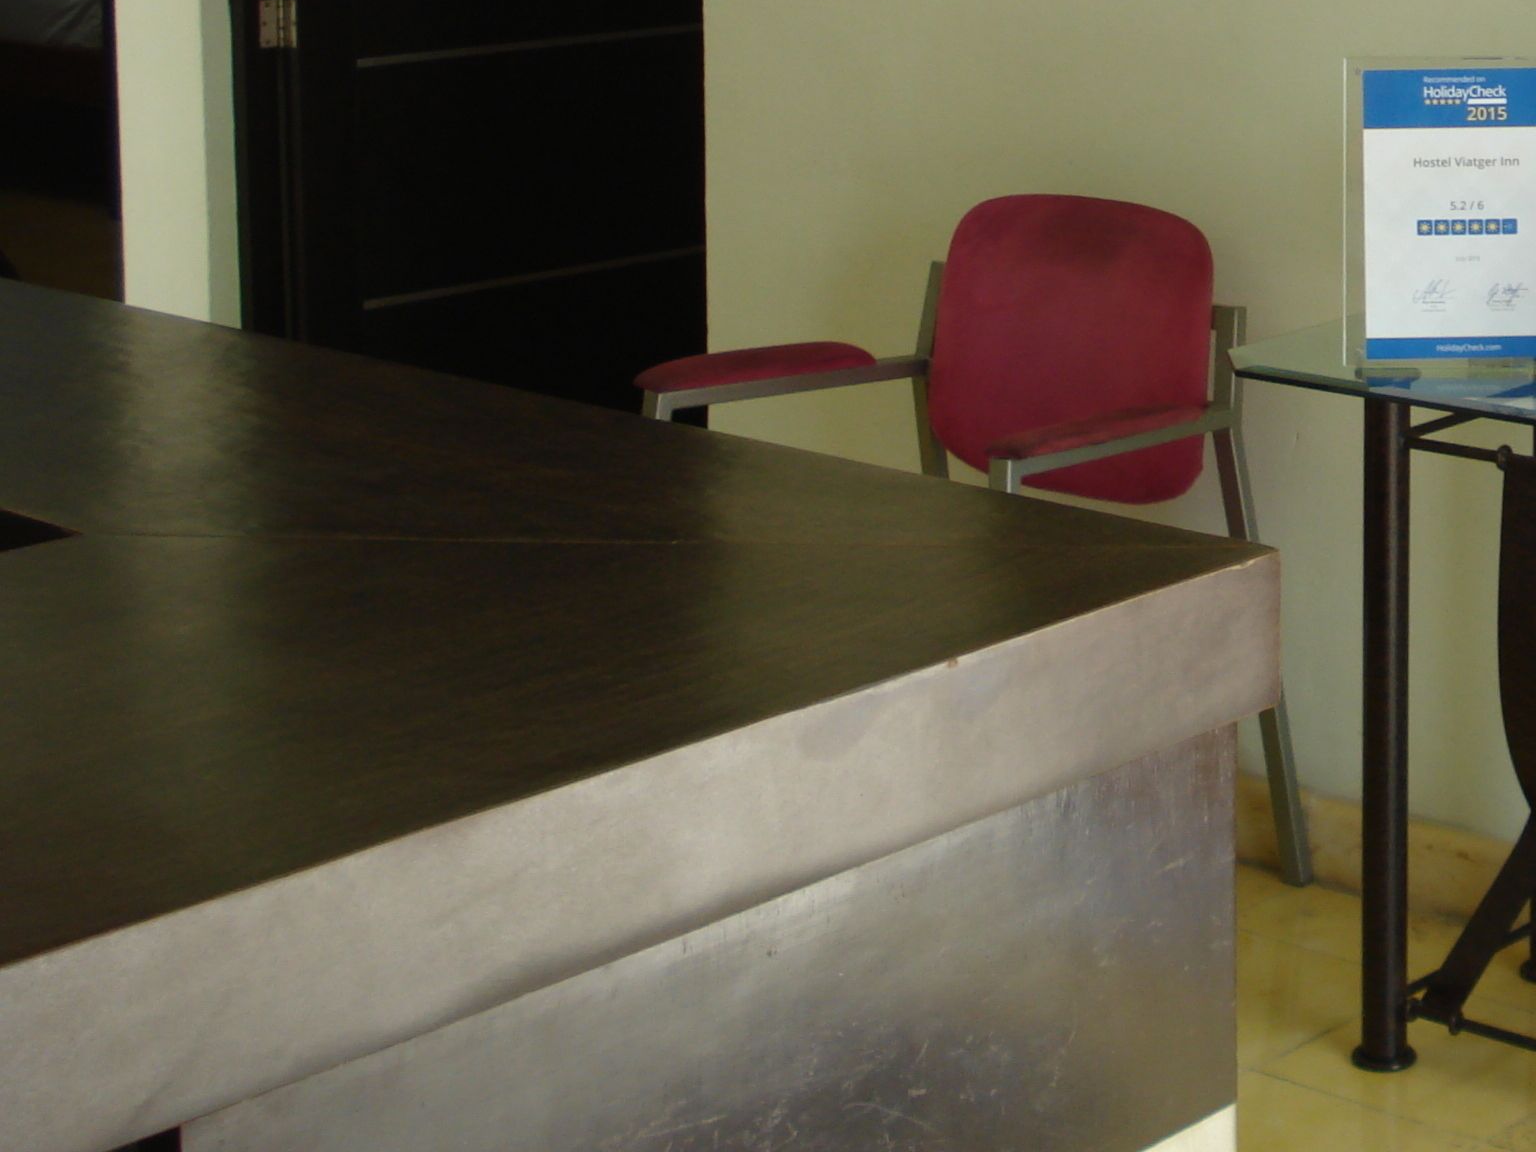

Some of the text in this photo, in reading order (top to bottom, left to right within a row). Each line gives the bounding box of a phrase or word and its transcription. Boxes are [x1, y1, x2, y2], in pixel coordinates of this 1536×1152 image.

[1423, 85, 1507, 101] HolidayCheck
[1467, 107, 1507, 121] 2015
[1413, 156, 1520, 169] Hostel Viatger Inn
